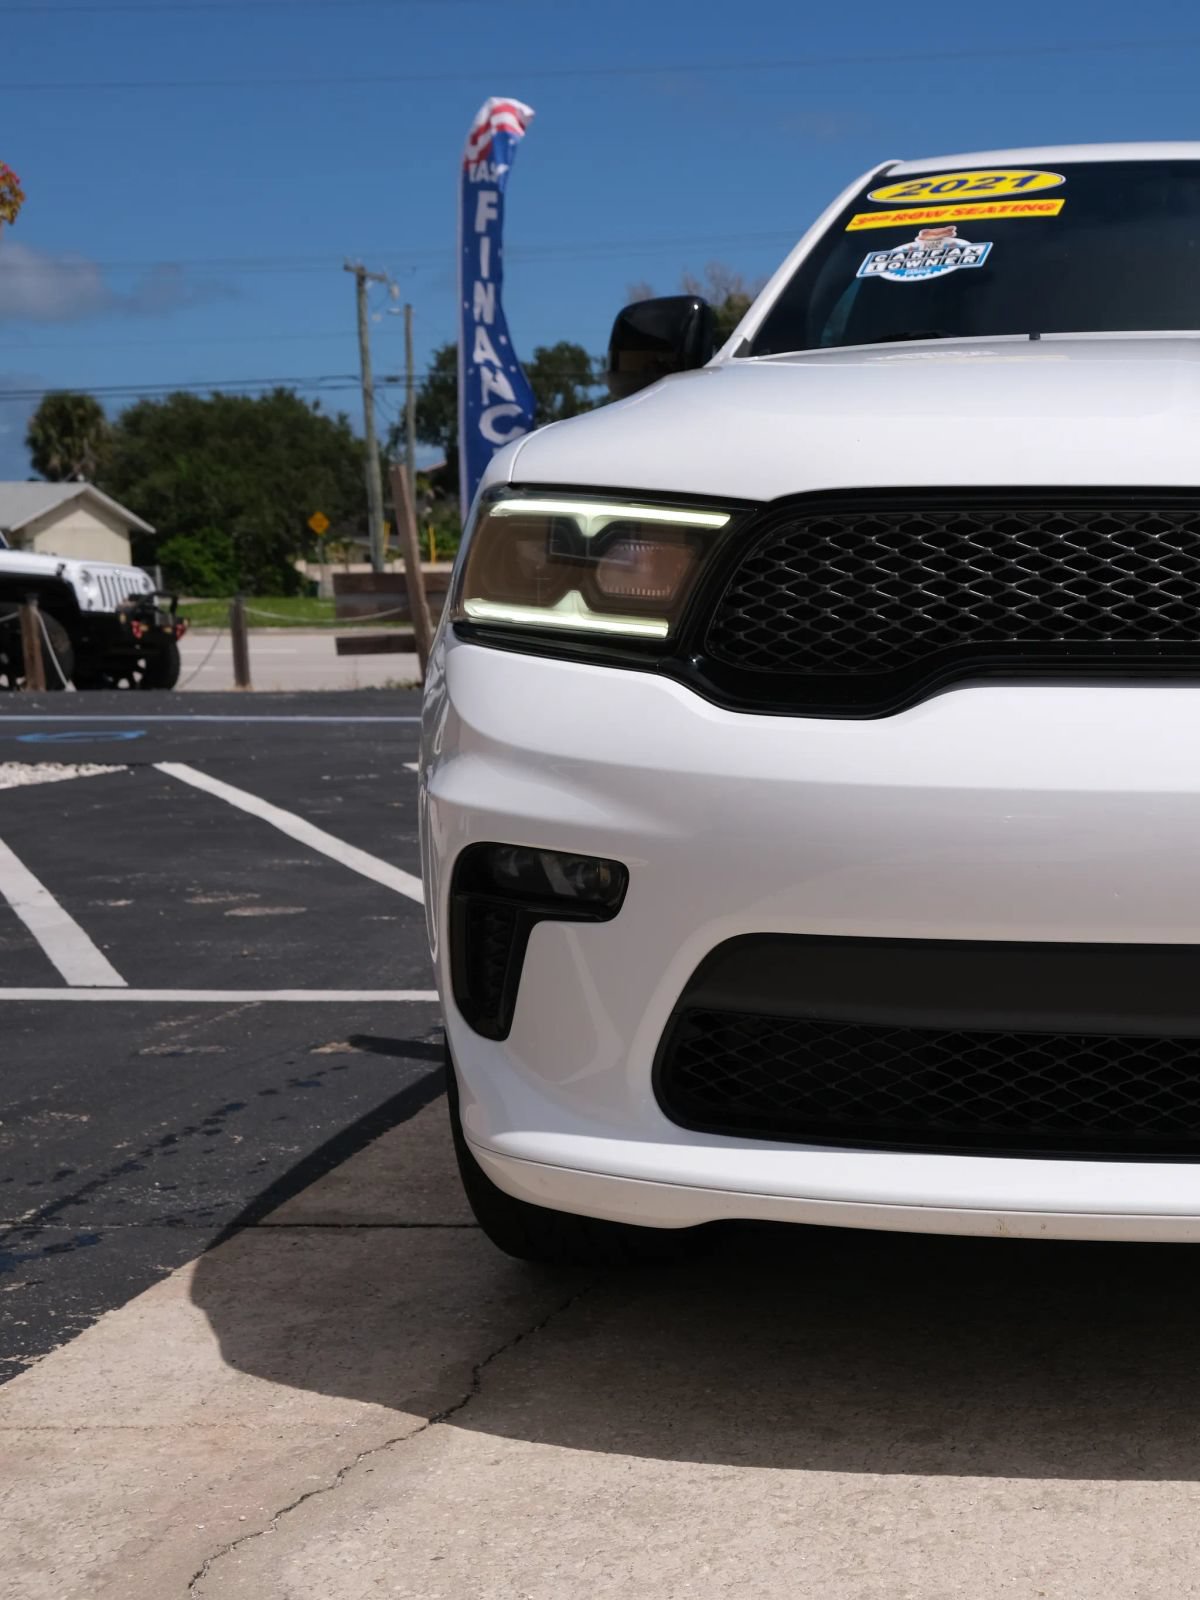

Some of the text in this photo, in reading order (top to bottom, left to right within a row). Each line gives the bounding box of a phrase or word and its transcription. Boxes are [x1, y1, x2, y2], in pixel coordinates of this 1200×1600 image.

[887, 173, 1041, 199] 2021
[892, 209, 948, 223] ROW
[949, 202, 1058, 217] SEATING
[873, 247, 981, 262] CARFAX
[887, 255, 977, 271] OWNER
[473, 190, 525, 457] FINANC
